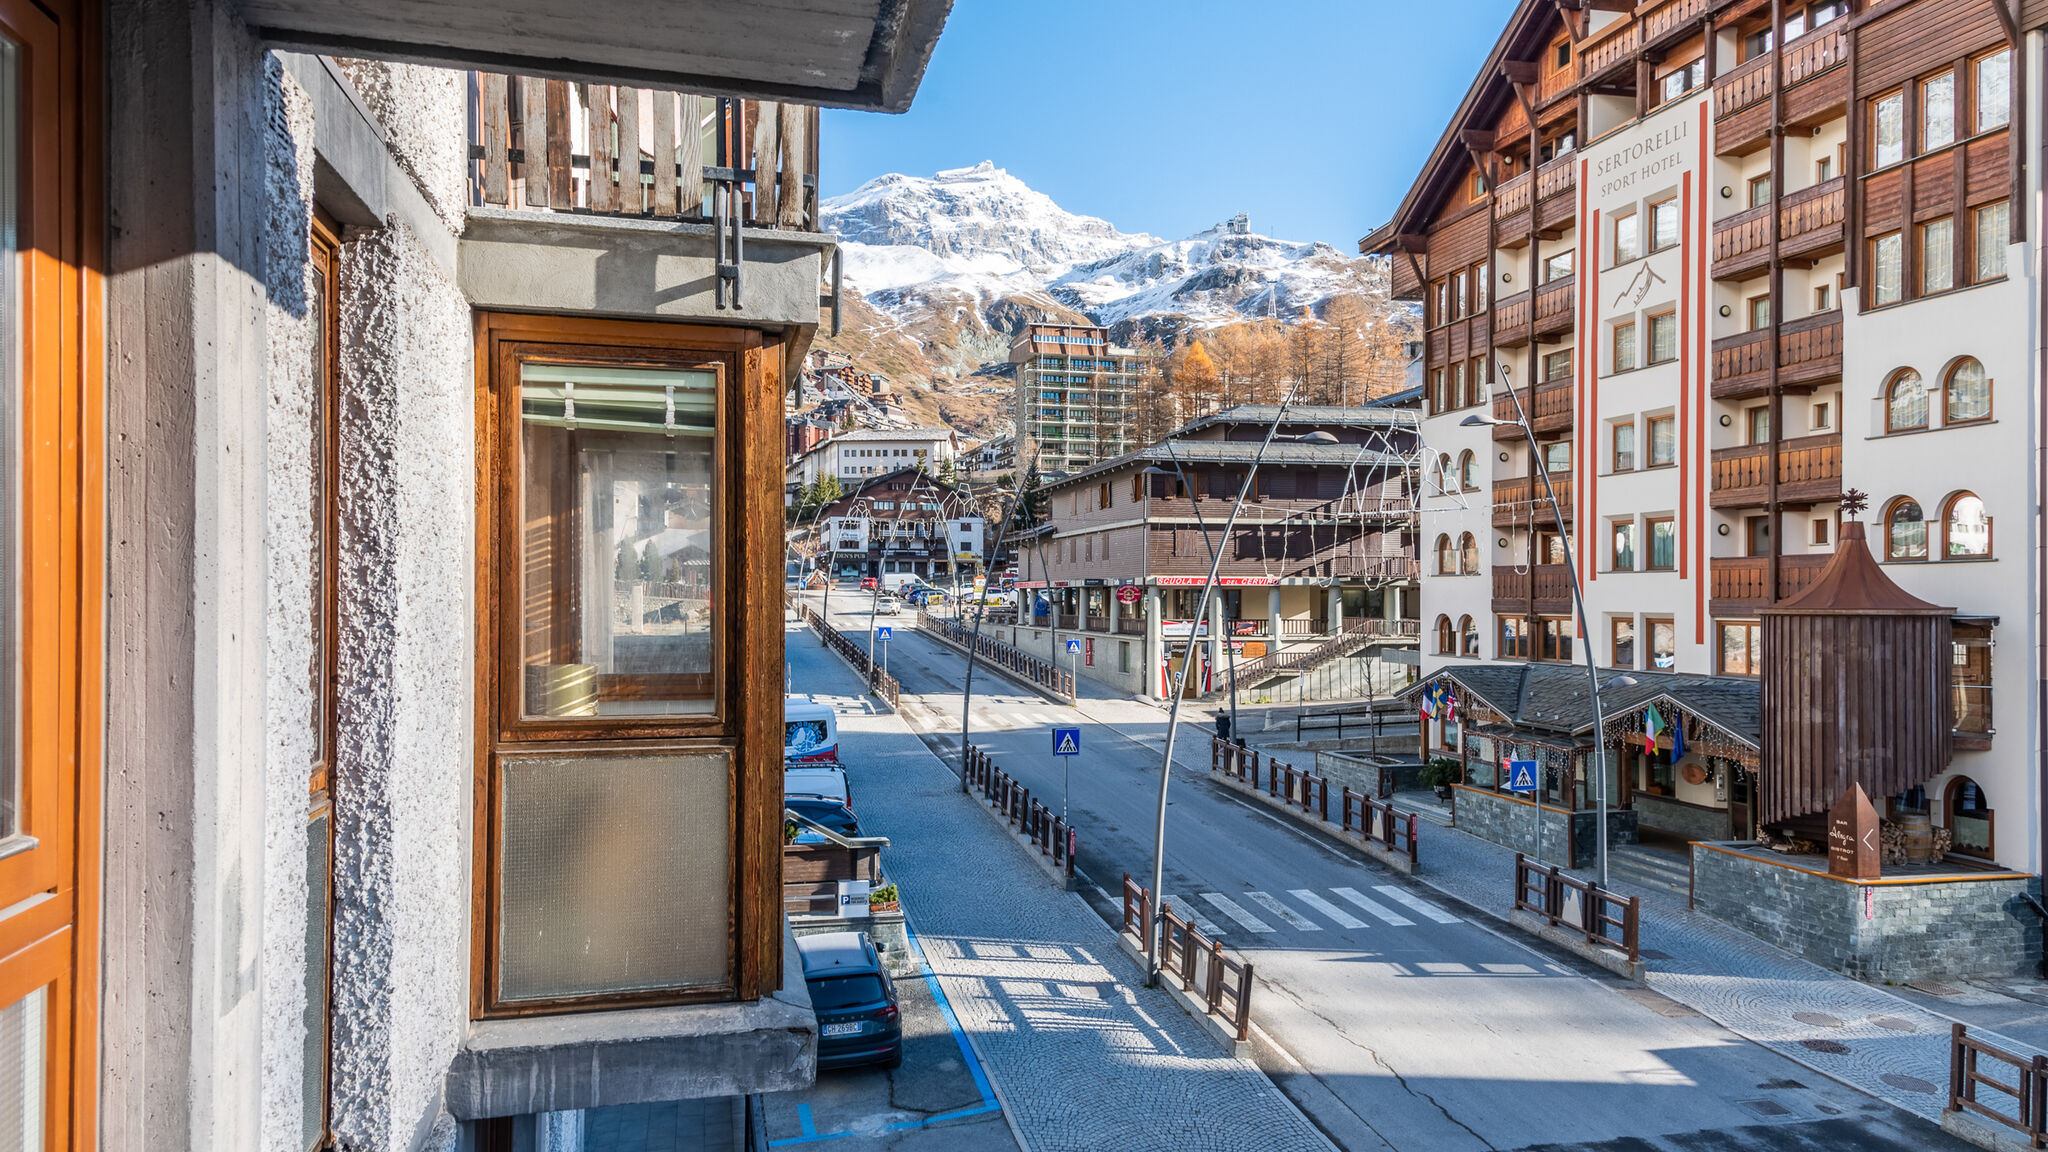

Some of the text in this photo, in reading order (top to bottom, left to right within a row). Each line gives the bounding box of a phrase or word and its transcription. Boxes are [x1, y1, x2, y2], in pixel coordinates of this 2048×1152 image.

[1597, 121, 1688, 177] SERTORELLI
[1601, 152, 1683, 198] SPORT HOTEL
[1157, 577, 1193, 585] SCUOLA
[843, 896, 849, 904] P
